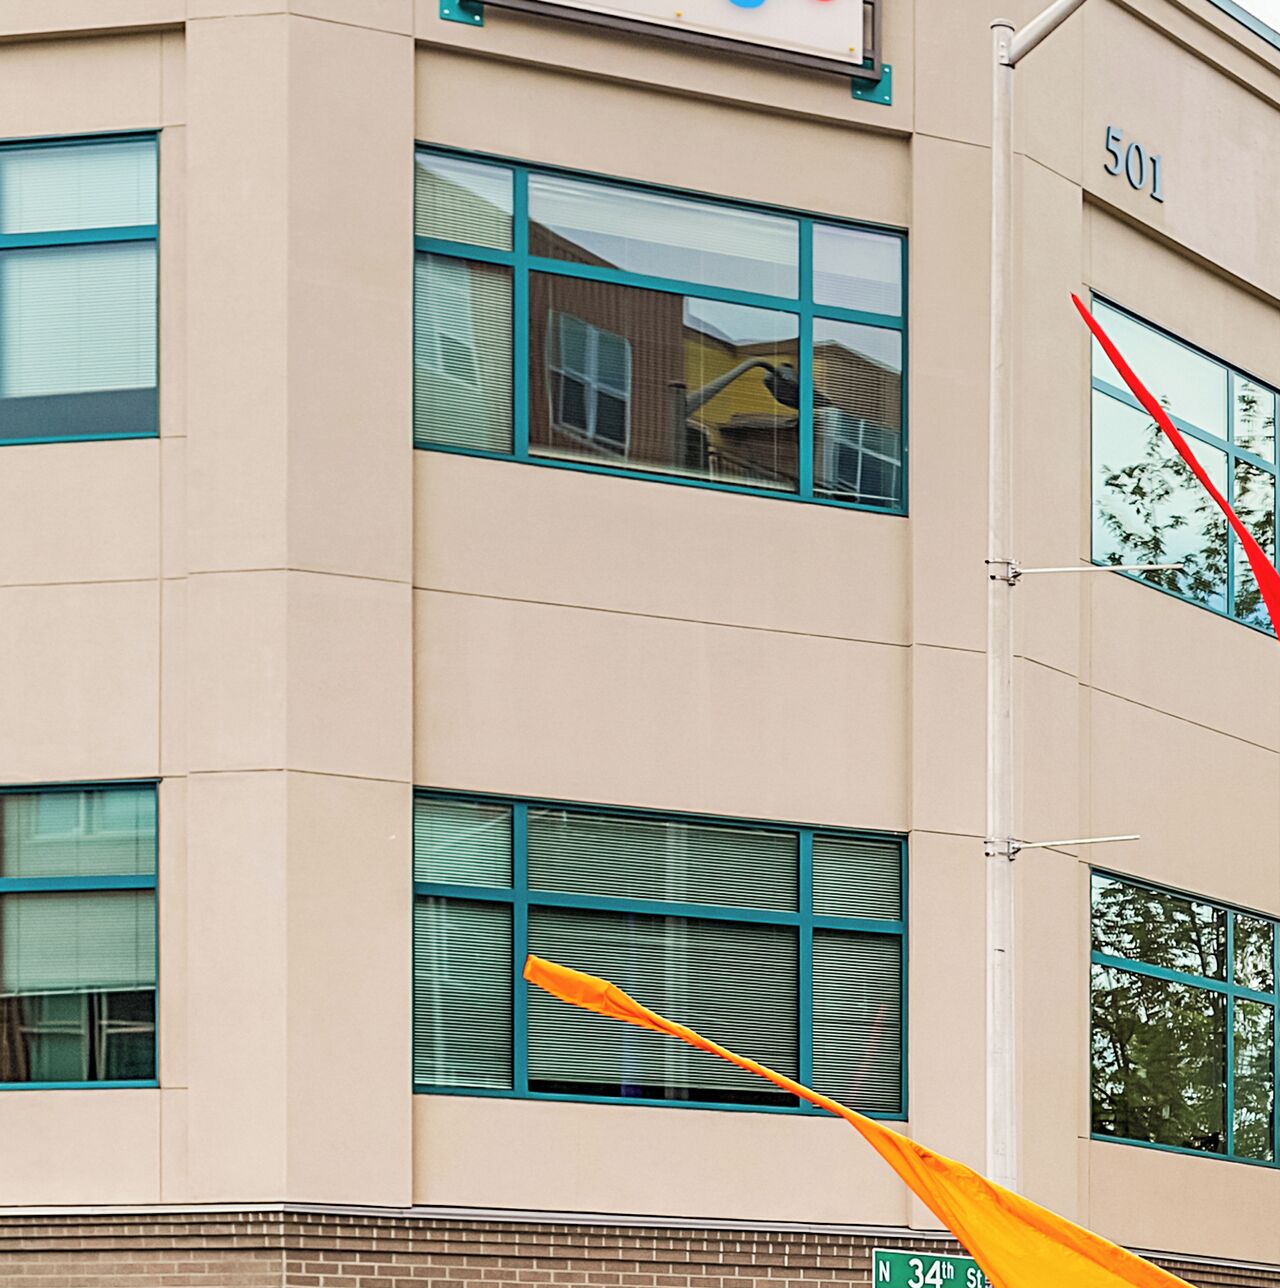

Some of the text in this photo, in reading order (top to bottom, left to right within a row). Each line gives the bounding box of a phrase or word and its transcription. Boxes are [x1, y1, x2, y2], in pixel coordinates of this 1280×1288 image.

[1104, 125, 1165, 203] 501
[879, 1260, 890, 1282] N
[966, 1268, 982, 1288] St
